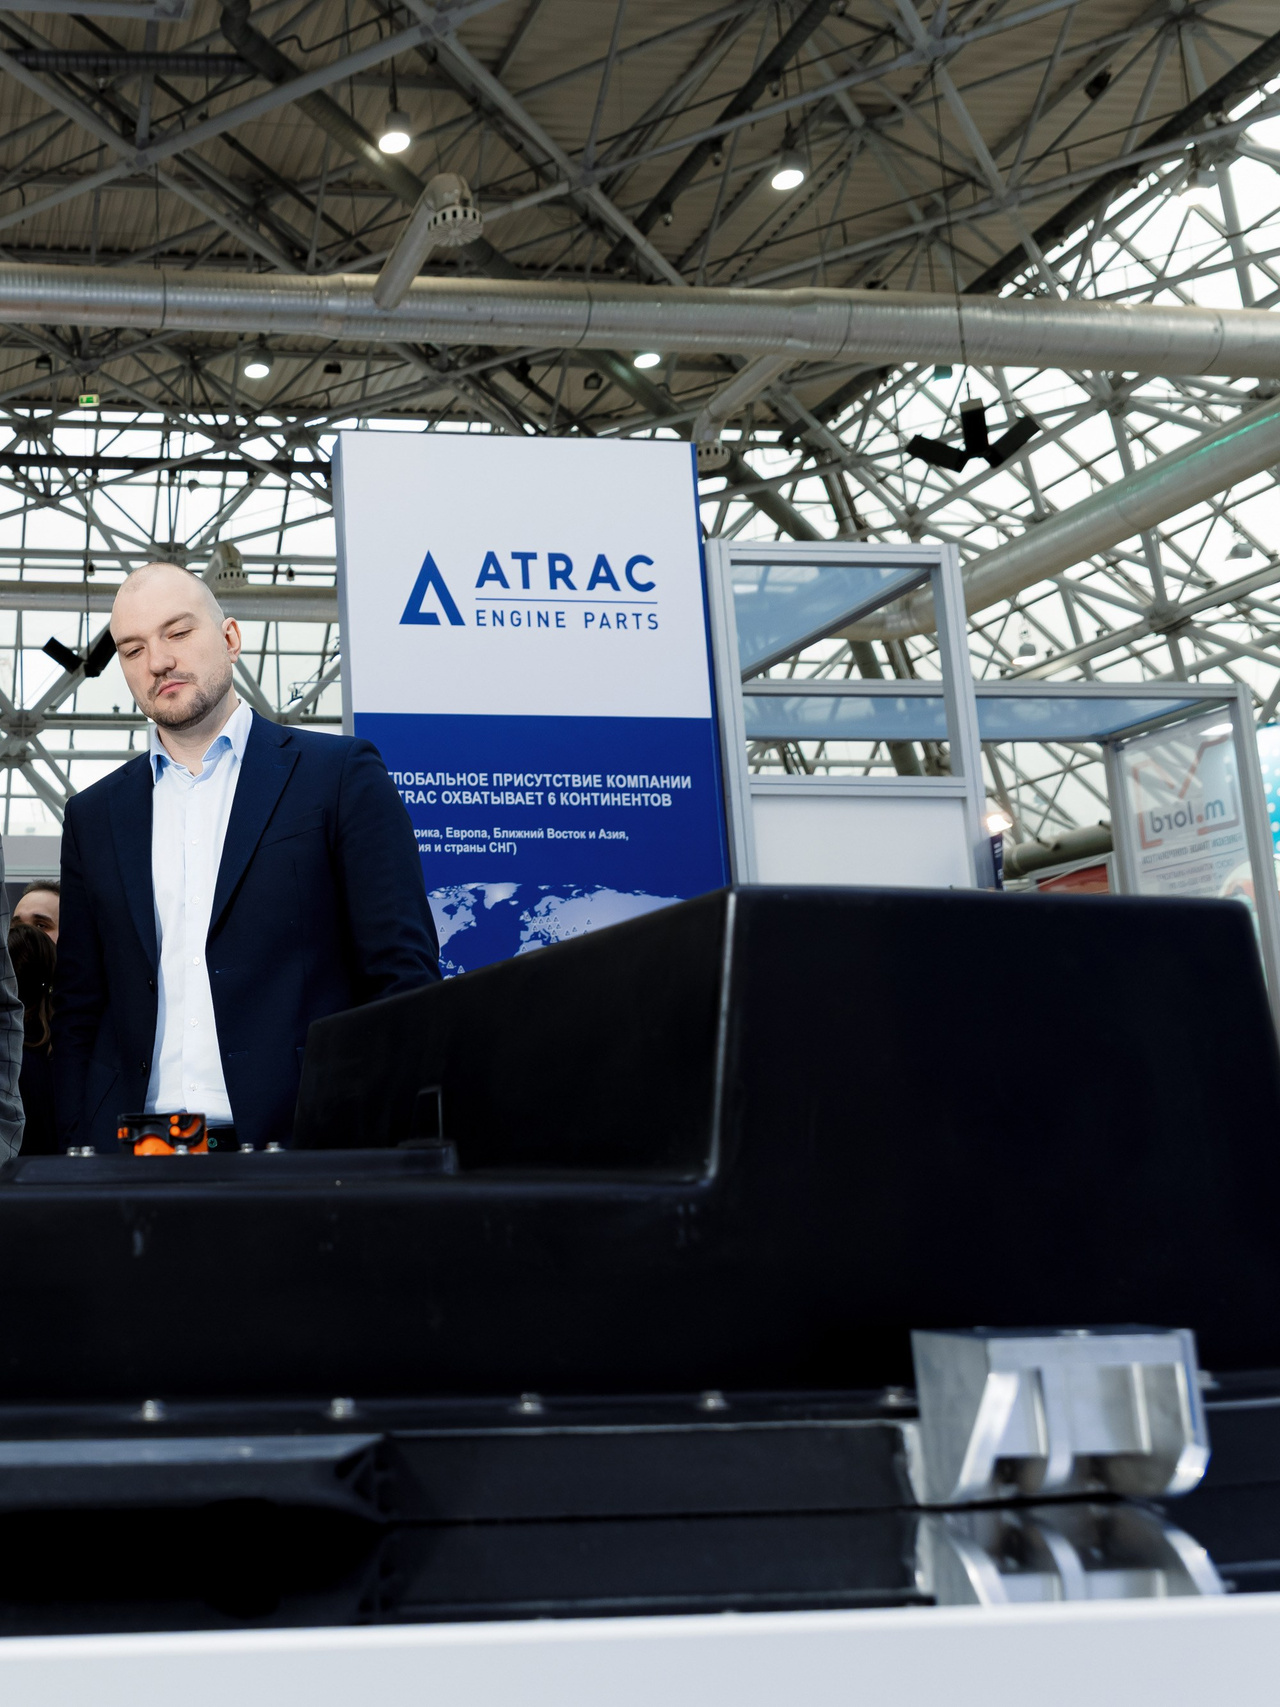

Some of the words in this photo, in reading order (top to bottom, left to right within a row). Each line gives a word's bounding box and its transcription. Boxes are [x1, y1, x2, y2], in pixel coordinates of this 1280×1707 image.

[475, 551, 657, 593] ATRAC
[476, 609, 566, 628] ENGINE
[584, 611, 659, 630] PARTS
[493, 773, 603, 788] ПРИСУТСТВИЕ
[606, 774, 692, 789] КОМПАНИИ
[397, 790, 437, 805] TRAC
[441, 790, 544, 806] ОХВАТЫВАЕТ
[547, 792, 557, 806] 6
[560, 792, 672, 807] КОНТИНЕНТОВ
[446, 827, 491, 841] Европа,
[493, 828, 544, 839] Ближний
[546, 828, 586, 840] Восток
[589, 831, 596, 839] и
[598, 829, 629, 841] Азия,
[434, 844, 442, 853] и
[444, 844, 487, 855] страны
[489, 842, 518, 855] СНГ)
